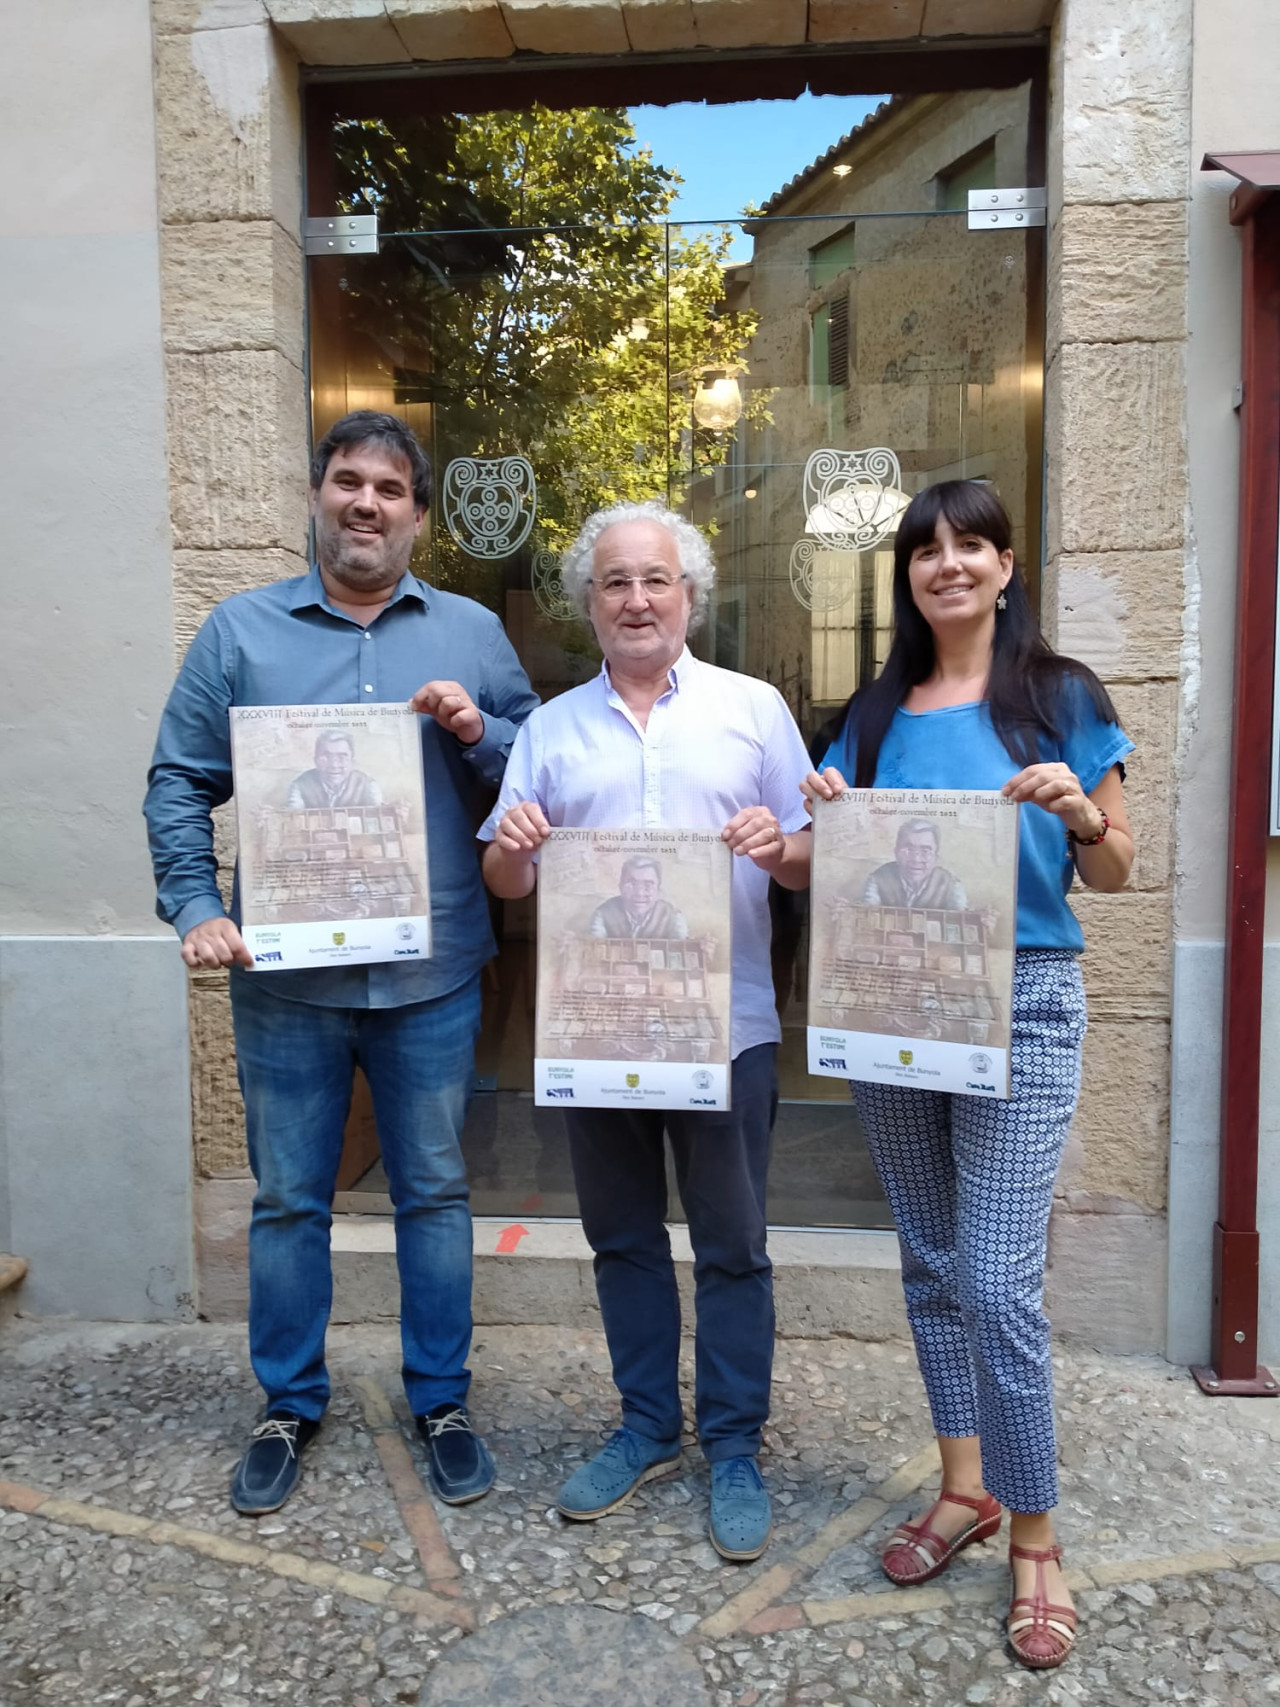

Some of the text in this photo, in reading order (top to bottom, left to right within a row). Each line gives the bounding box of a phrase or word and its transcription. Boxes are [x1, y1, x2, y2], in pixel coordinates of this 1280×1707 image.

[285, 707, 319, 719] Festival
[321, 706, 331, 718] de
[367, 705, 378, 716] de
[870, 791, 906, 804] Festival
[908, 792, 920, 804] de
[922, 792, 957, 805] Música
[959, 793, 972, 805] de
[593, 831, 628, 842] Festival
[630, 831, 641, 842] de
[643, 831, 676, 842] Música
[678, 831, 689, 842] de
[691, 832, 725, 845] Bunyol
